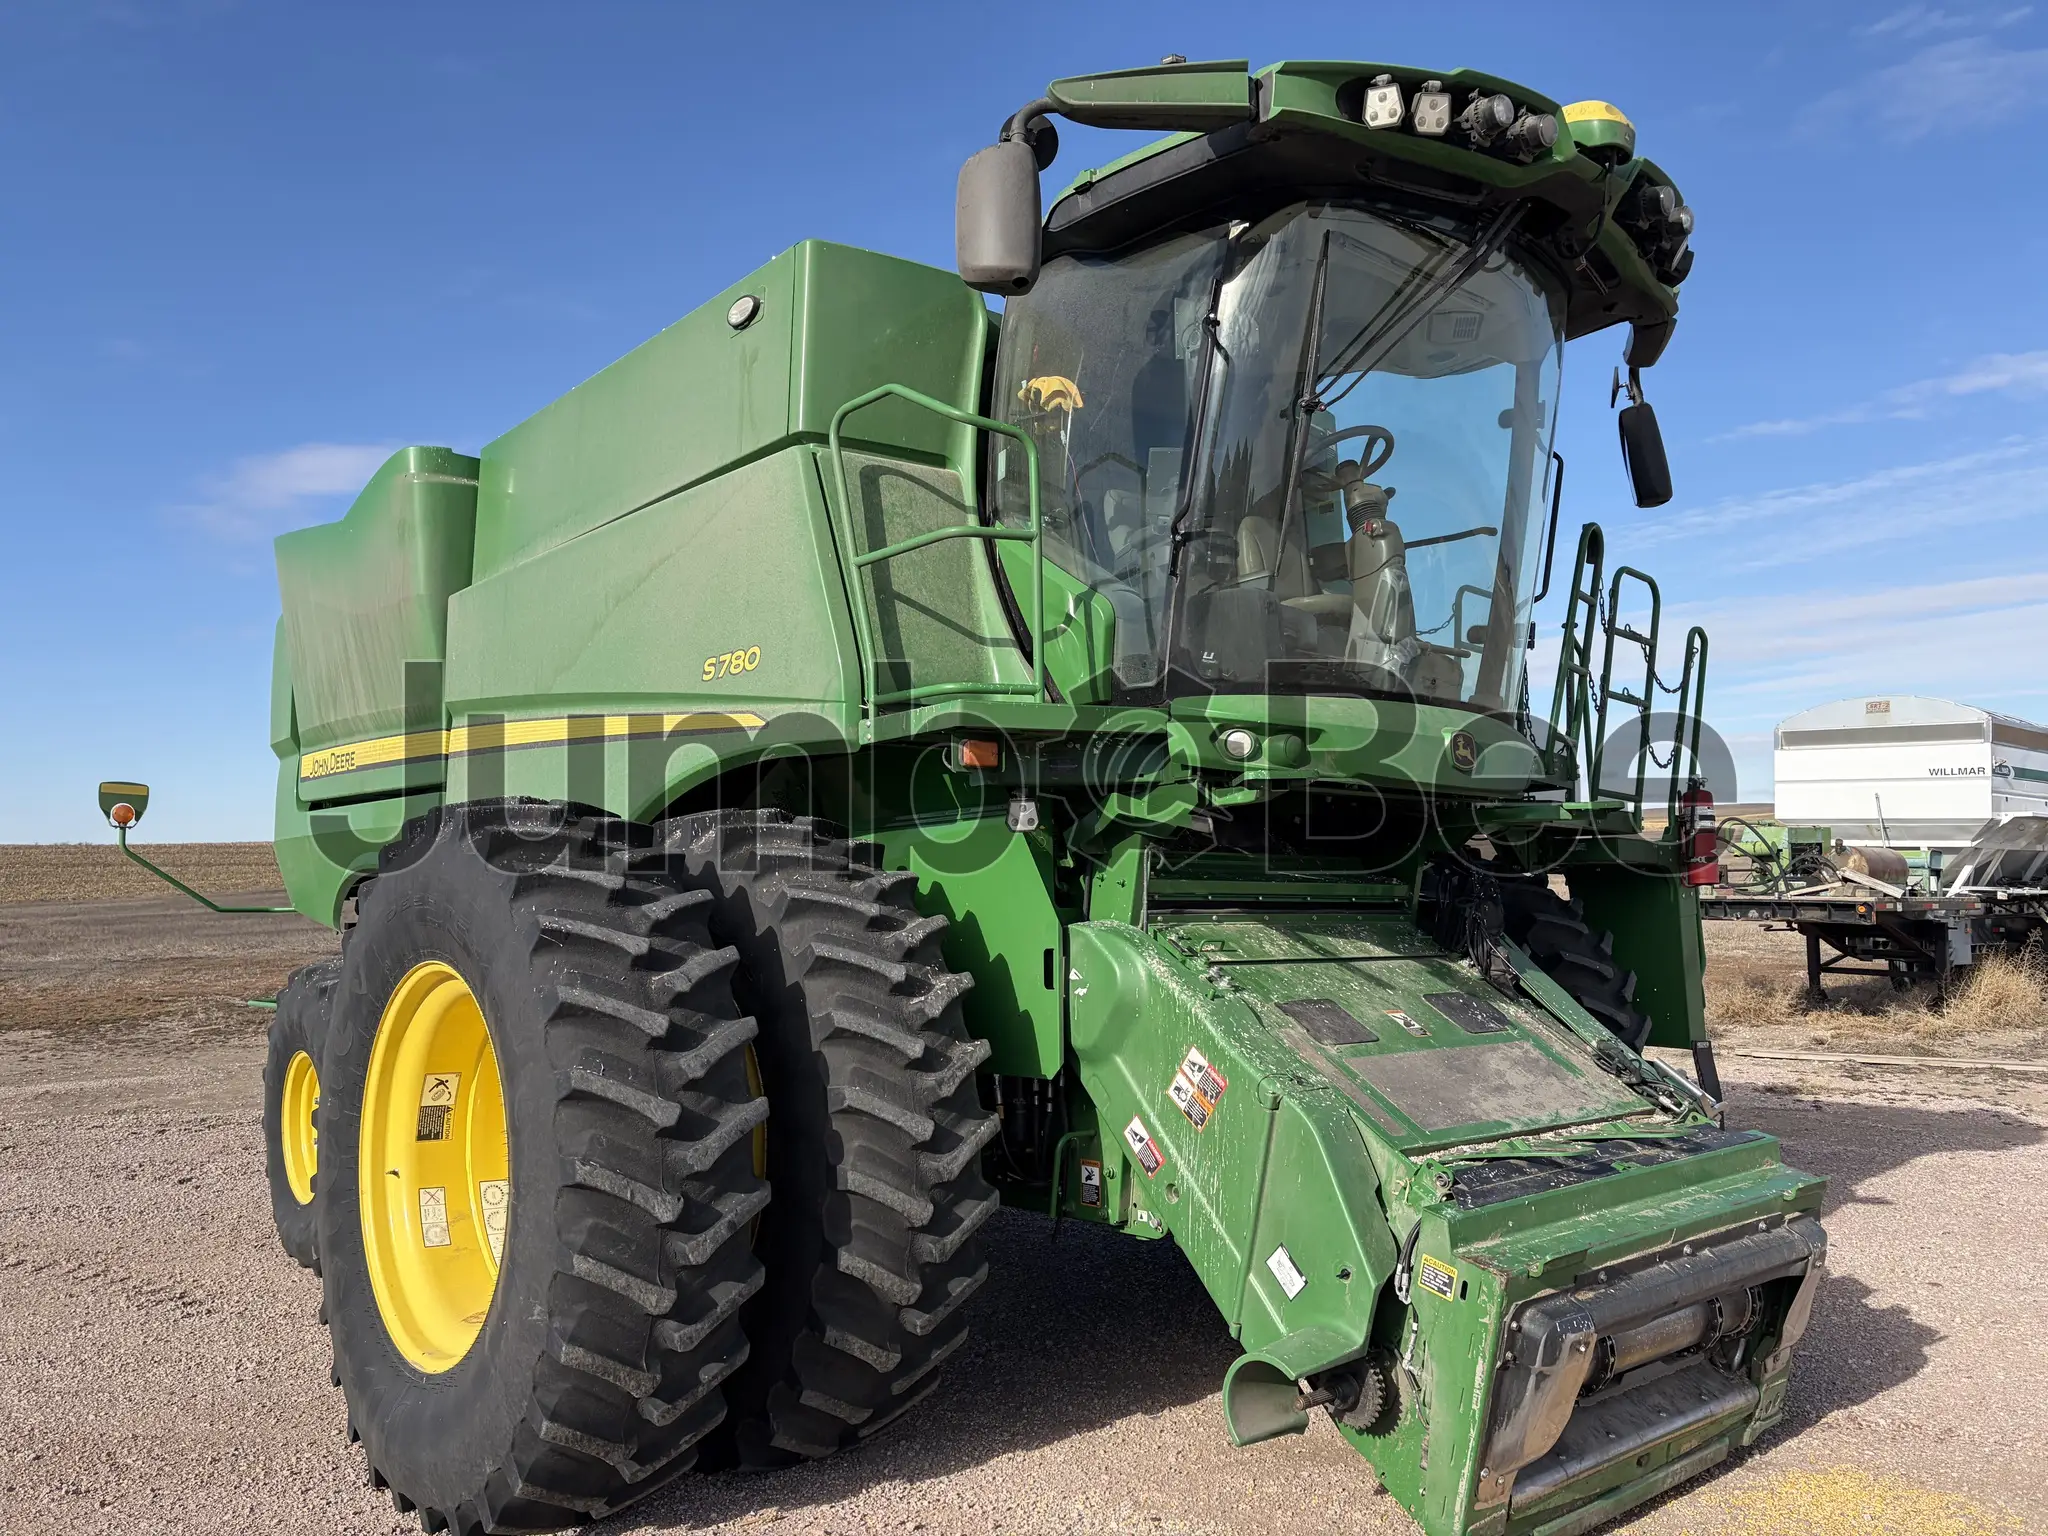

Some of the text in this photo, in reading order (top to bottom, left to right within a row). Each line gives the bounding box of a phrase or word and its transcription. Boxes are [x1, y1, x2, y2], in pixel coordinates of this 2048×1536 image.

[702, 644, 761, 682] S780
[309, 751, 356, 776] JOHN DEERE
[1928, 767, 1986, 776] WILLMAR
[444, 1112, 452, 1140] CAUTION
[1428, 1258, 1456, 1276] CAUTION
